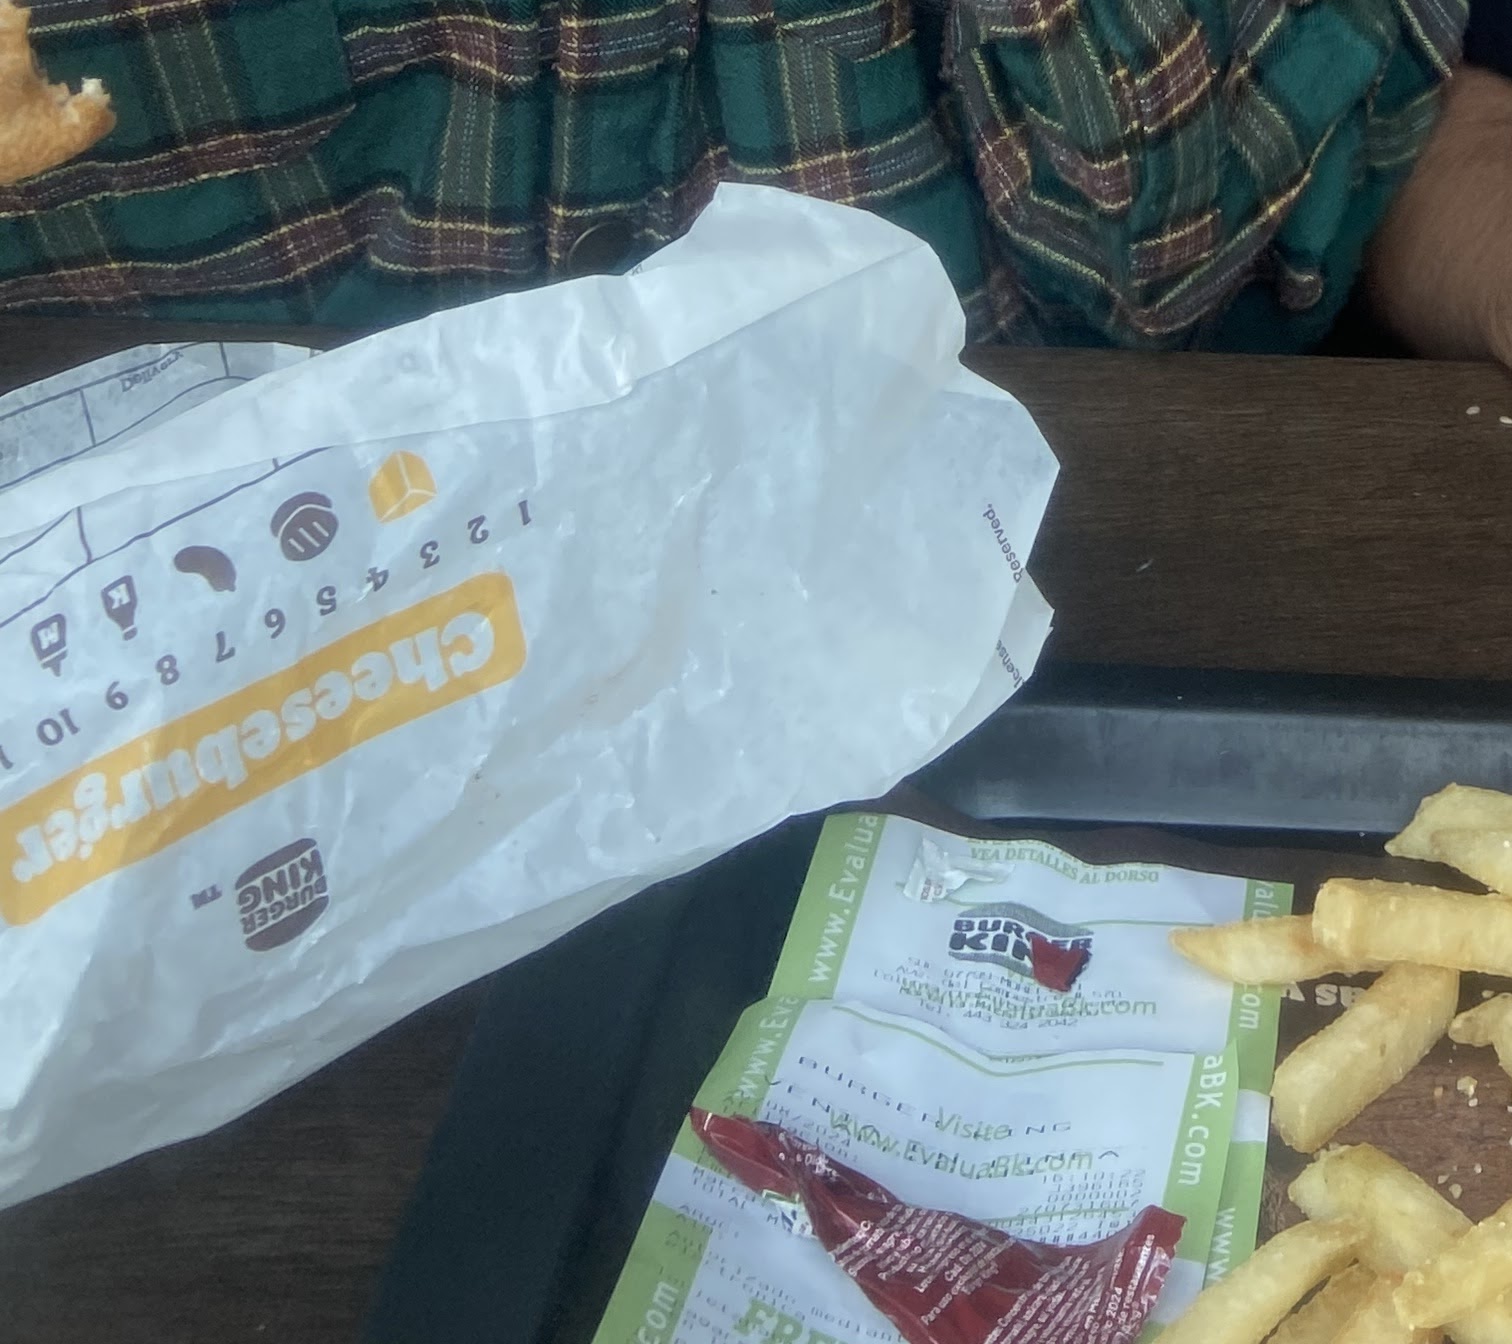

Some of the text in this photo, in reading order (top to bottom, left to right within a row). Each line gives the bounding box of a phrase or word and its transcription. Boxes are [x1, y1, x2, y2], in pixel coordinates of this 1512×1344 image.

[12, 612, 495, 883] Cheeseburger
[236, 848, 328, 937] BURGER KING
